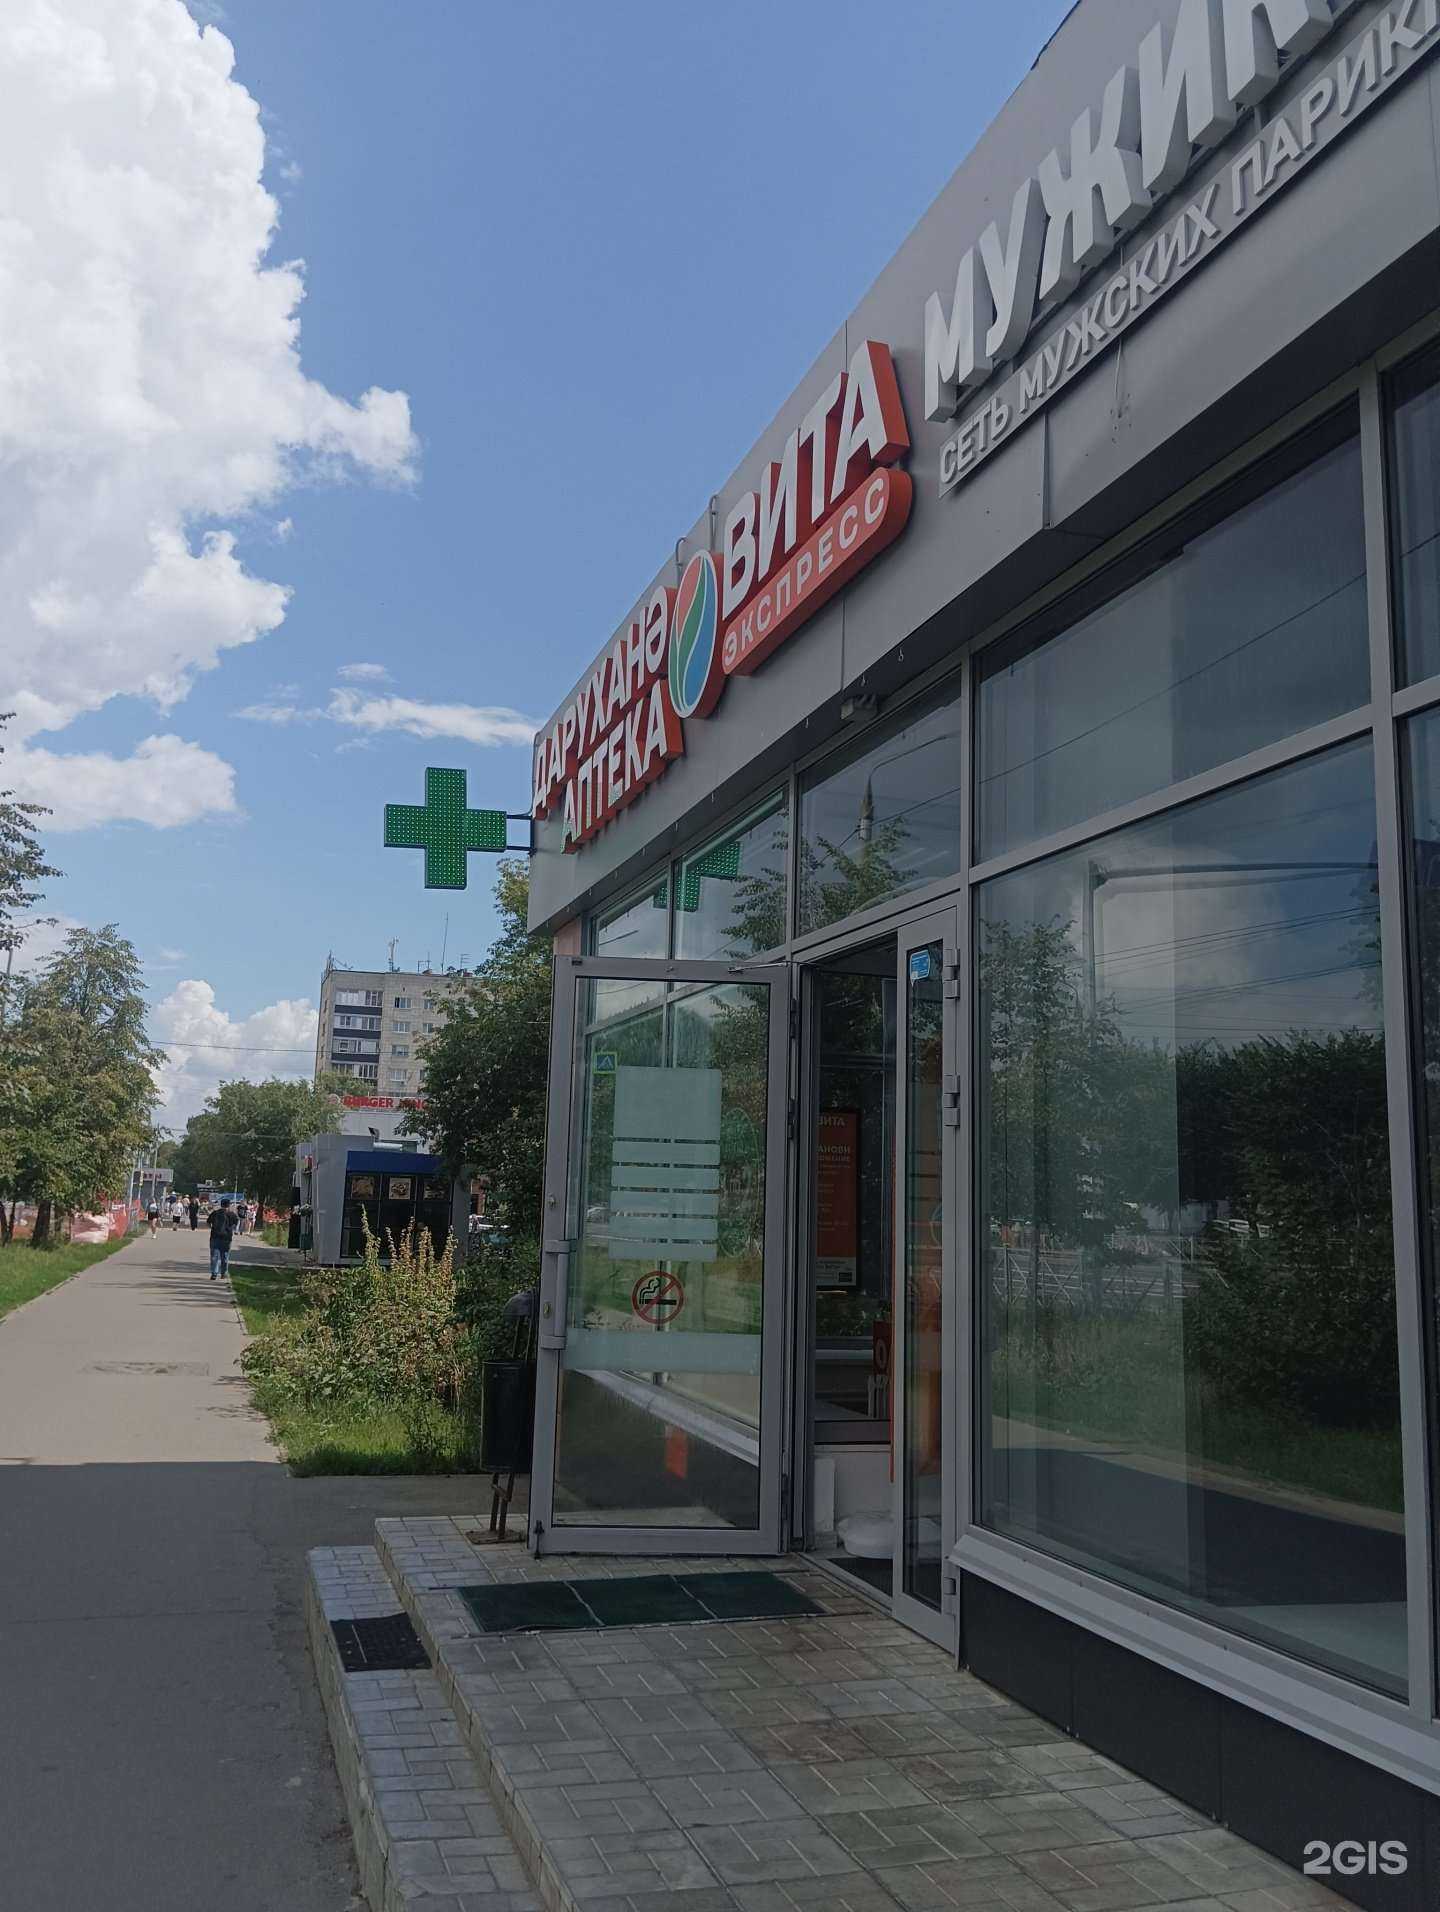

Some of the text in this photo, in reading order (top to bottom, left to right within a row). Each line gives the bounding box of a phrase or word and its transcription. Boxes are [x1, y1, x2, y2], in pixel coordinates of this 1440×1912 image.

[940, 0, 1440, 484] СЕТЬ МУЖСКИХ ПАРИК
[722, 340, 896, 621] ВИТА
[724, 477, 886, 667] ЭКСПРЕСС
[532, 585, 669, 820] ДАРУХАНӘ
[561, 680, 668, 854] АПТЕКА
